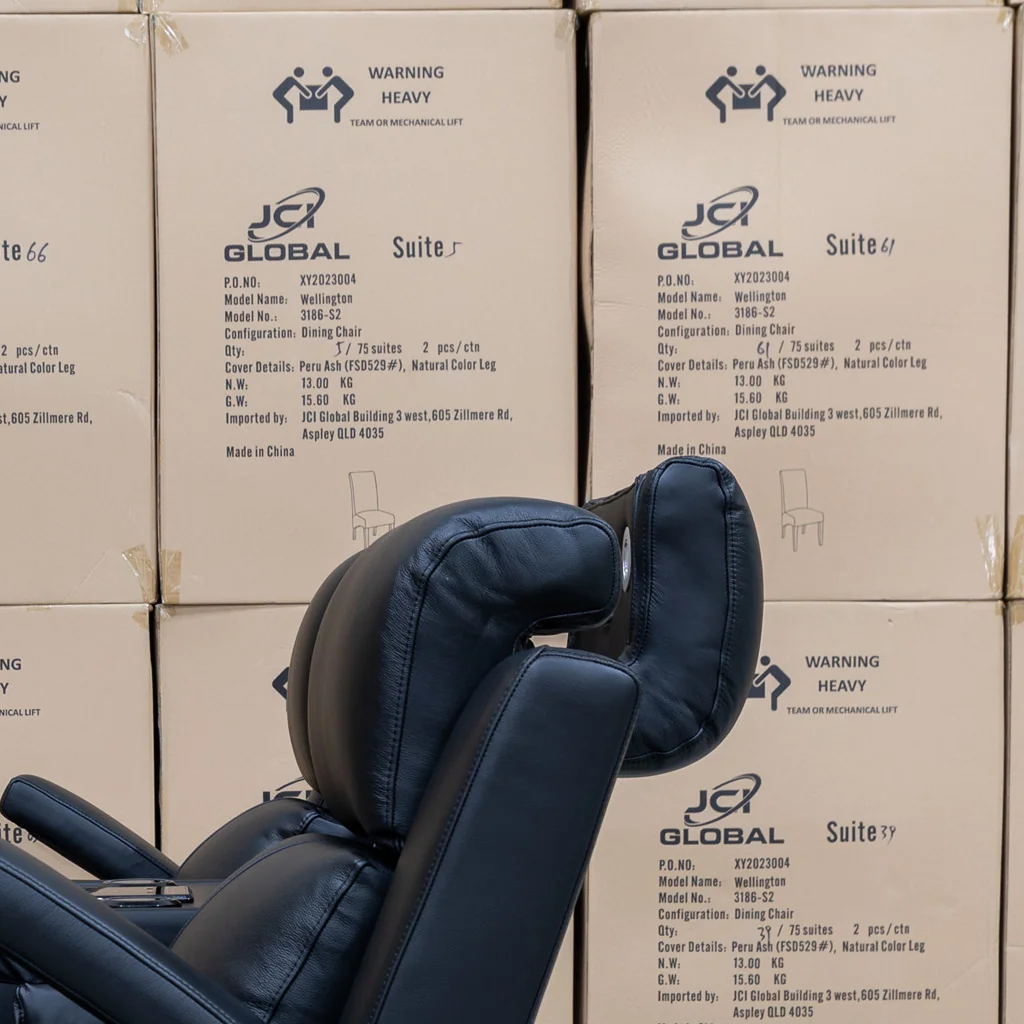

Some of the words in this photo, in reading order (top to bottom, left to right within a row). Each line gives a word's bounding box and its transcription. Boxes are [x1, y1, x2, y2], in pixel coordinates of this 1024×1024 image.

[368, 65, 444, 80] WARNING
[800, 63, 877, 78] WARNING
[381, 91, 432, 104] HEAVY
[814, 88, 864, 103] HEAVY
[23, 122, 41, 131] LIFT
[350, 118, 375, 127] TEAM
[375, 118, 389, 127] OR
[389, 118, 446, 127] MECHANICAL
[446, 118, 464, 126] LIFT
[782, 117, 807, 126] TEAM
[808, 116, 821, 125] OR
[822, 115, 878, 125] MECHANICAL
[879, 115, 896, 124] LIFT
[25, 240, 50, 264] 66
[223, 242, 351, 263] GLOBAL
[392, 235, 444, 259] Suite
[444, 240, 464, 259] 5
[657, 239, 784, 261] GLOBAL
[826, 232, 877, 256] Suite
[879, 235, 896, 258] 61
[224, 275, 261, 289] P.O.NO:
[299, 272, 357, 287] XY2023004
[657, 273, 694, 287] P.O.NO:
[734, 270, 790, 284] XY2023004
[657, 342, 678, 357] Qty:
[756, 339, 771, 359] 61
[790, 340, 802, 353] 75
[804, 339, 835, 353] suites
[854, 338, 861, 352] 2
[29, 361, 56, 374] Color
[58, 361, 76, 376] Leg
[226, 445, 253, 458] Made
[255, 445, 264, 458] in
[266, 445, 295, 458] China
[805, 655, 880, 669] WARNING
[818, 679, 867, 692] HEAVY
[24, 708, 41, 717] LIFT
[786, 706, 811, 715] TEAM
[811, 706, 825, 715] OR
[825, 706, 881, 715] MECHANICAL
[881, 705, 898, 714] LIFT
[659, 827, 785, 846] GLOBAL
[826, 820, 877, 844] Suite
[659, 858, 695, 872] P.O.NO:
[734, 856, 791, 870] XY2023004
[734, 891, 775, 904] 3186-S2
[657, 957, 681, 969] N.W:
[733, 957, 761, 970] 13.00
[771, 956, 784, 969] KG
